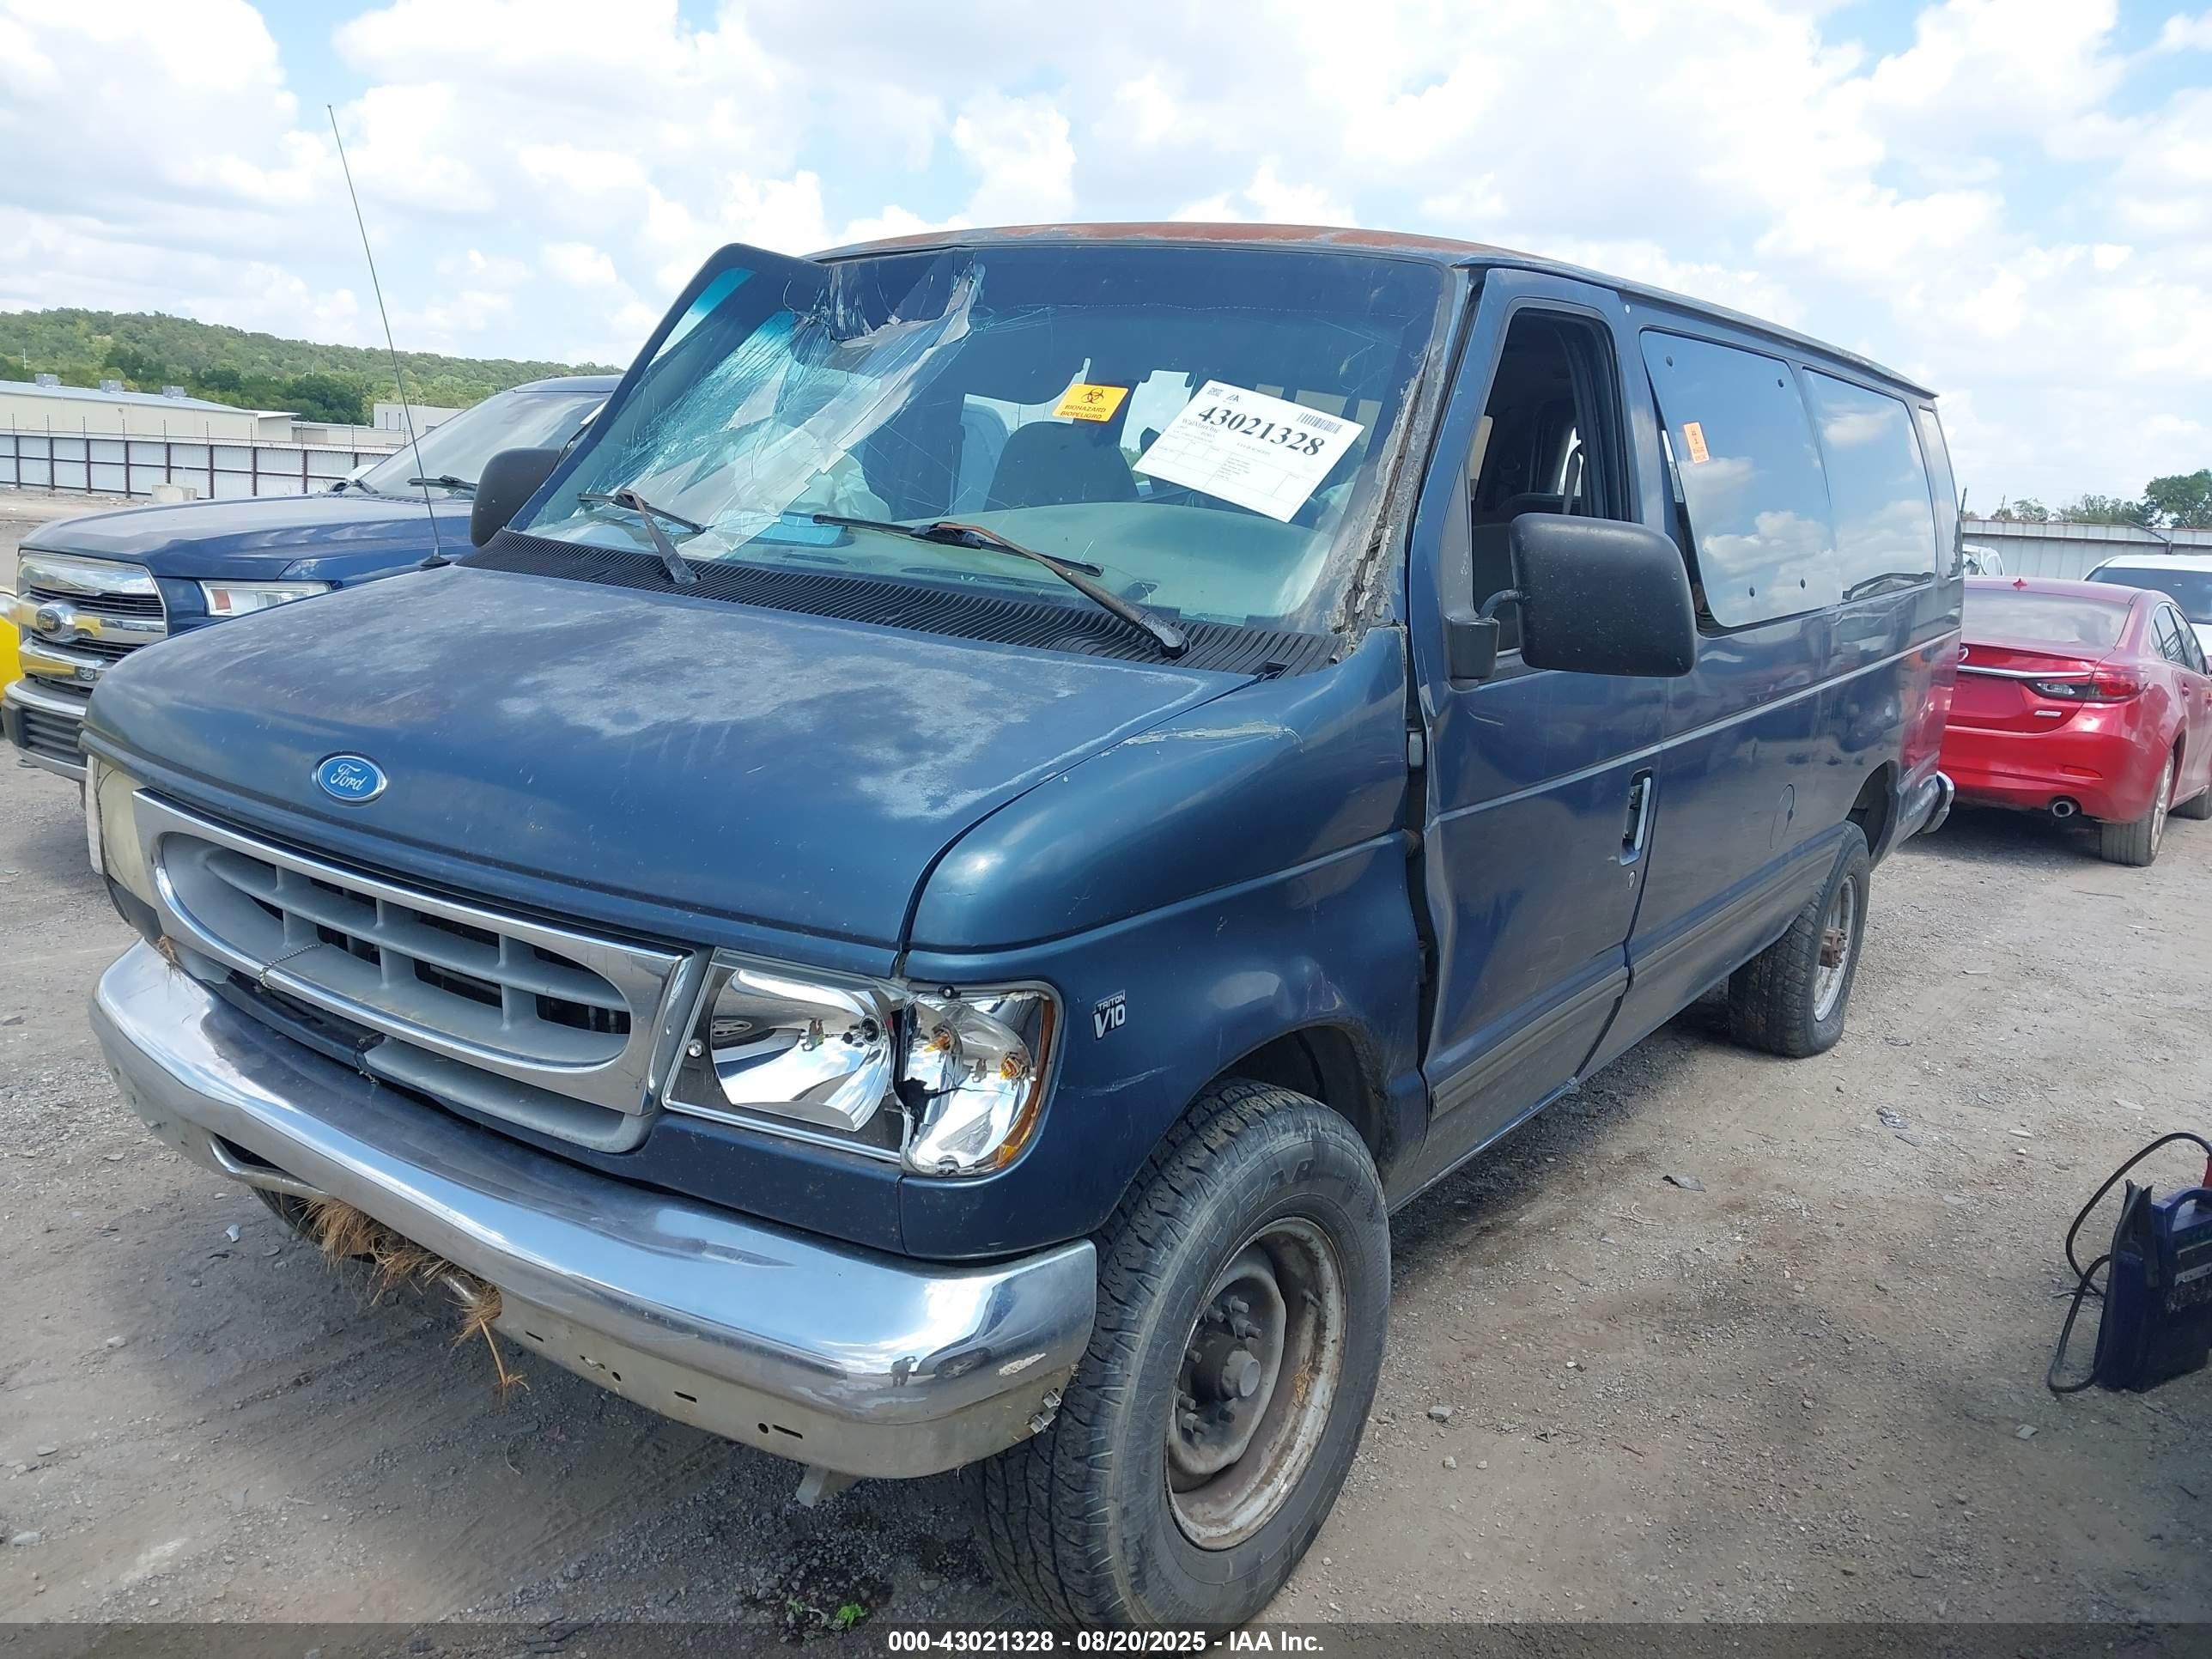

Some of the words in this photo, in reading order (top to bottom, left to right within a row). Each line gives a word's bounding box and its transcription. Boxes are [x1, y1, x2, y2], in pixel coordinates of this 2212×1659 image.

[1060, 410, 1102, 419] BIOPELIGRO
[1065, 404, 1106, 413] BIOHAZARD
[1198, 406, 1325, 456] 43021328
[330, 763, 368, 791] Ford
[1097, 992, 1126, 1011] TRITON
[1094, 1004, 1126, 1038] V10
